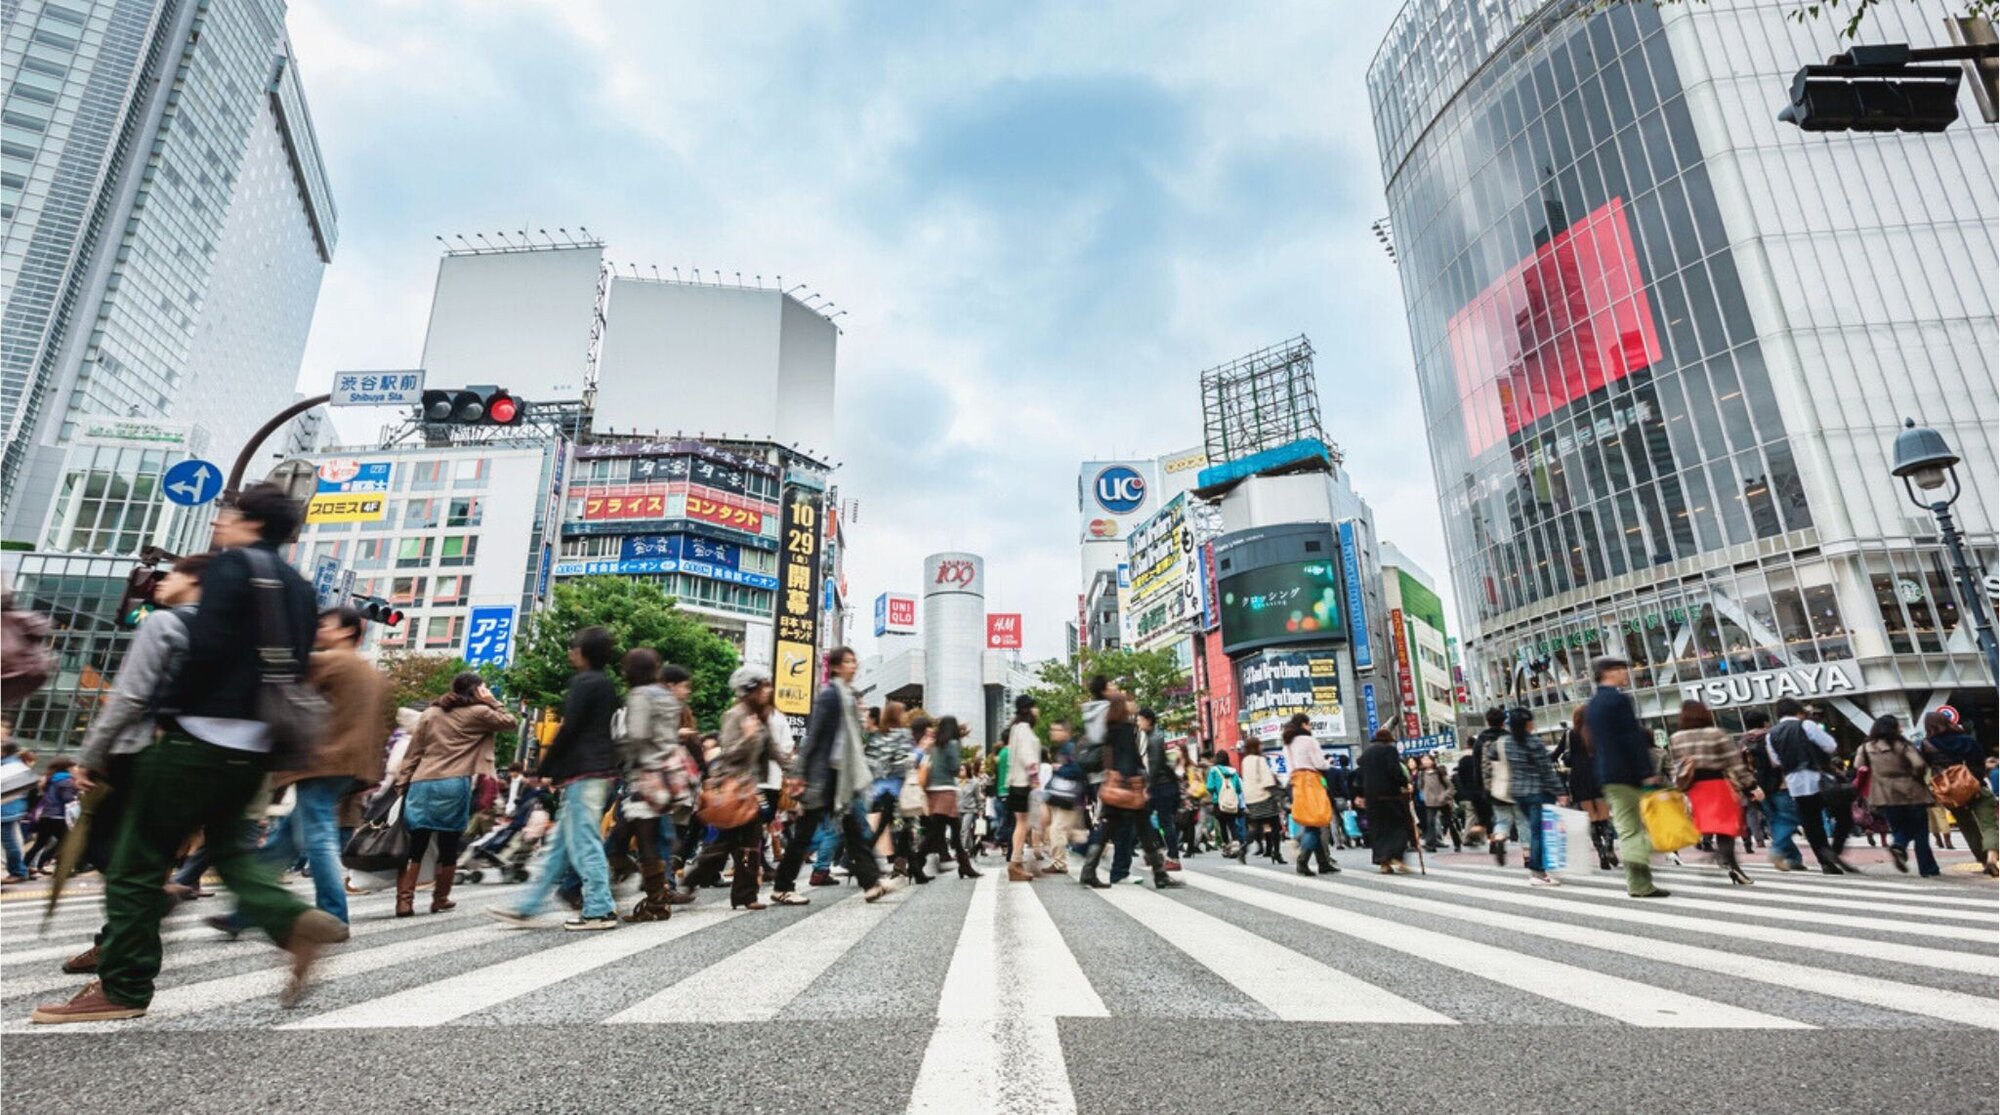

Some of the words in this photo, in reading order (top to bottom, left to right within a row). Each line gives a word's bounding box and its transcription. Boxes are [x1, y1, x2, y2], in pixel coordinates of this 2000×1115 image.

[340, 375, 417, 391] 渋谷駅前
[350, 393, 385, 402] Shibuya
[687, 498, 759, 526] コンタクト
[788, 529, 815, 555] 29
[935, 565, 975, 588] 109
[892, 602, 911, 611] UNI
[892, 613, 912, 622] QLO
[1684, 664, 1855, 706] TSUTAYA
[788, 717, 805, 727] BS
